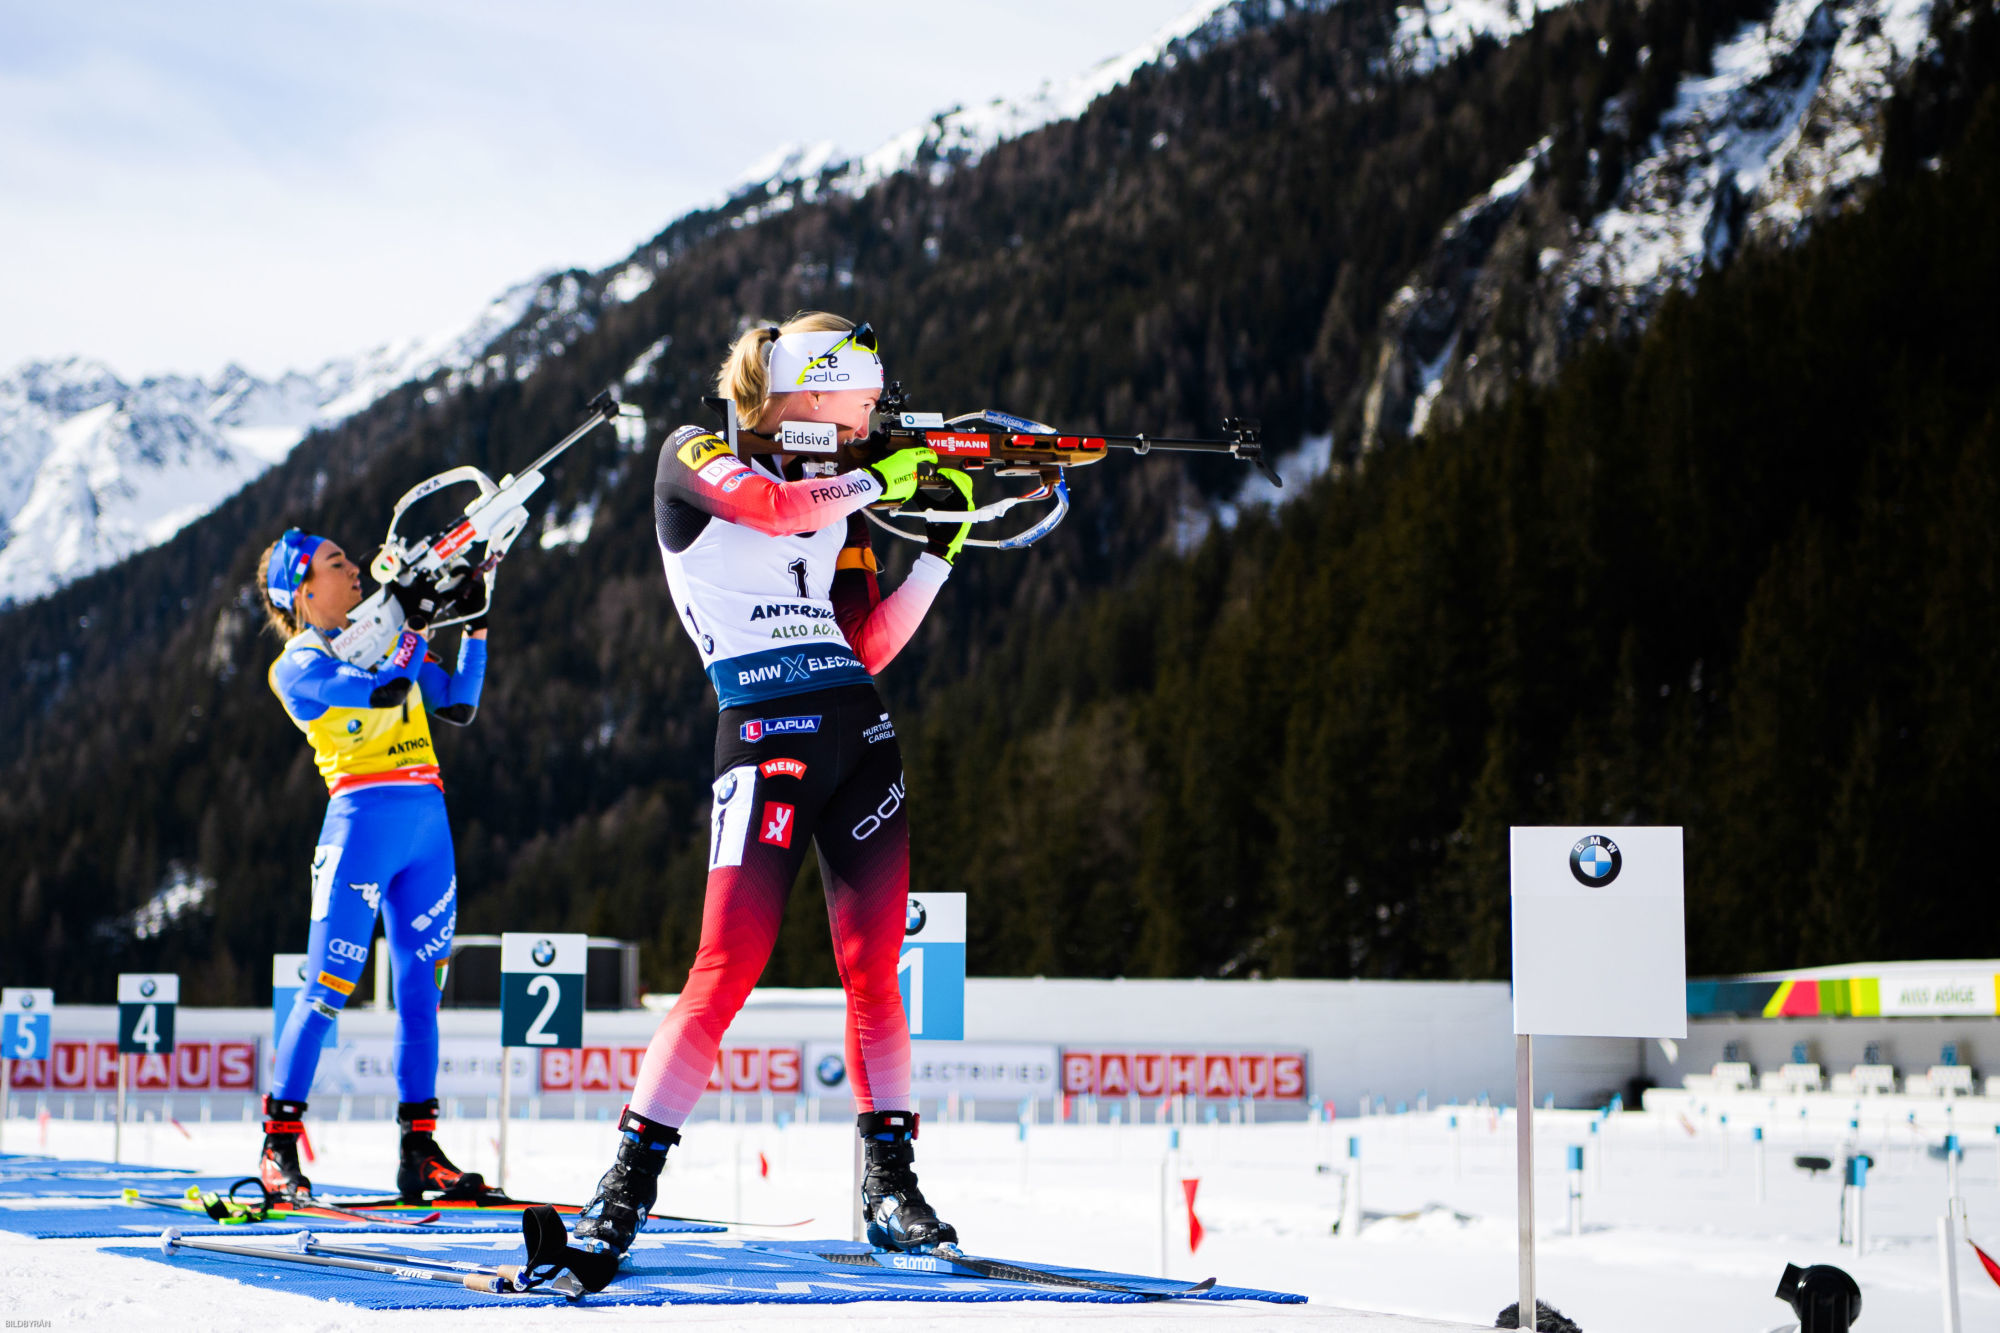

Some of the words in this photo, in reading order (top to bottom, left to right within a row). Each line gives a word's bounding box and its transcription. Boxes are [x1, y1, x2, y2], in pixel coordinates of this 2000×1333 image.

[784, 430, 830, 446] Eidsiva
[810, 479, 872, 503] FROLAND
[788, 558, 808, 598] 1
[772, 625, 808, 639] ALTO
[738, 664, 781, 686] BMW
[765, 719, 815, 731] LAPUA
[863, 721, 893, 738] HURTIGR
[388, 738, 430, 756] ANTHOL
[868, 730, 896, 744] CARGLA
[765, 761, 803, 774] MENY
[1574, 836, 1617, 854] BMW
[416, 911, 457, 962] FALCO
[897, 947, 924, 1034] 1
[525, 975, 561, 1046] 2
[15, 1015, 37, 1060] 5
[132, 1004, 160, 1053] 4
[13, 1047, 251, 1085] AUHAUS
[543, 1049, 799, 1088] BAUUS
[911, 1062, 1051, 1082] LECTRIFIED
[1066, 1057, 1303, 1094] BAUHAUS
